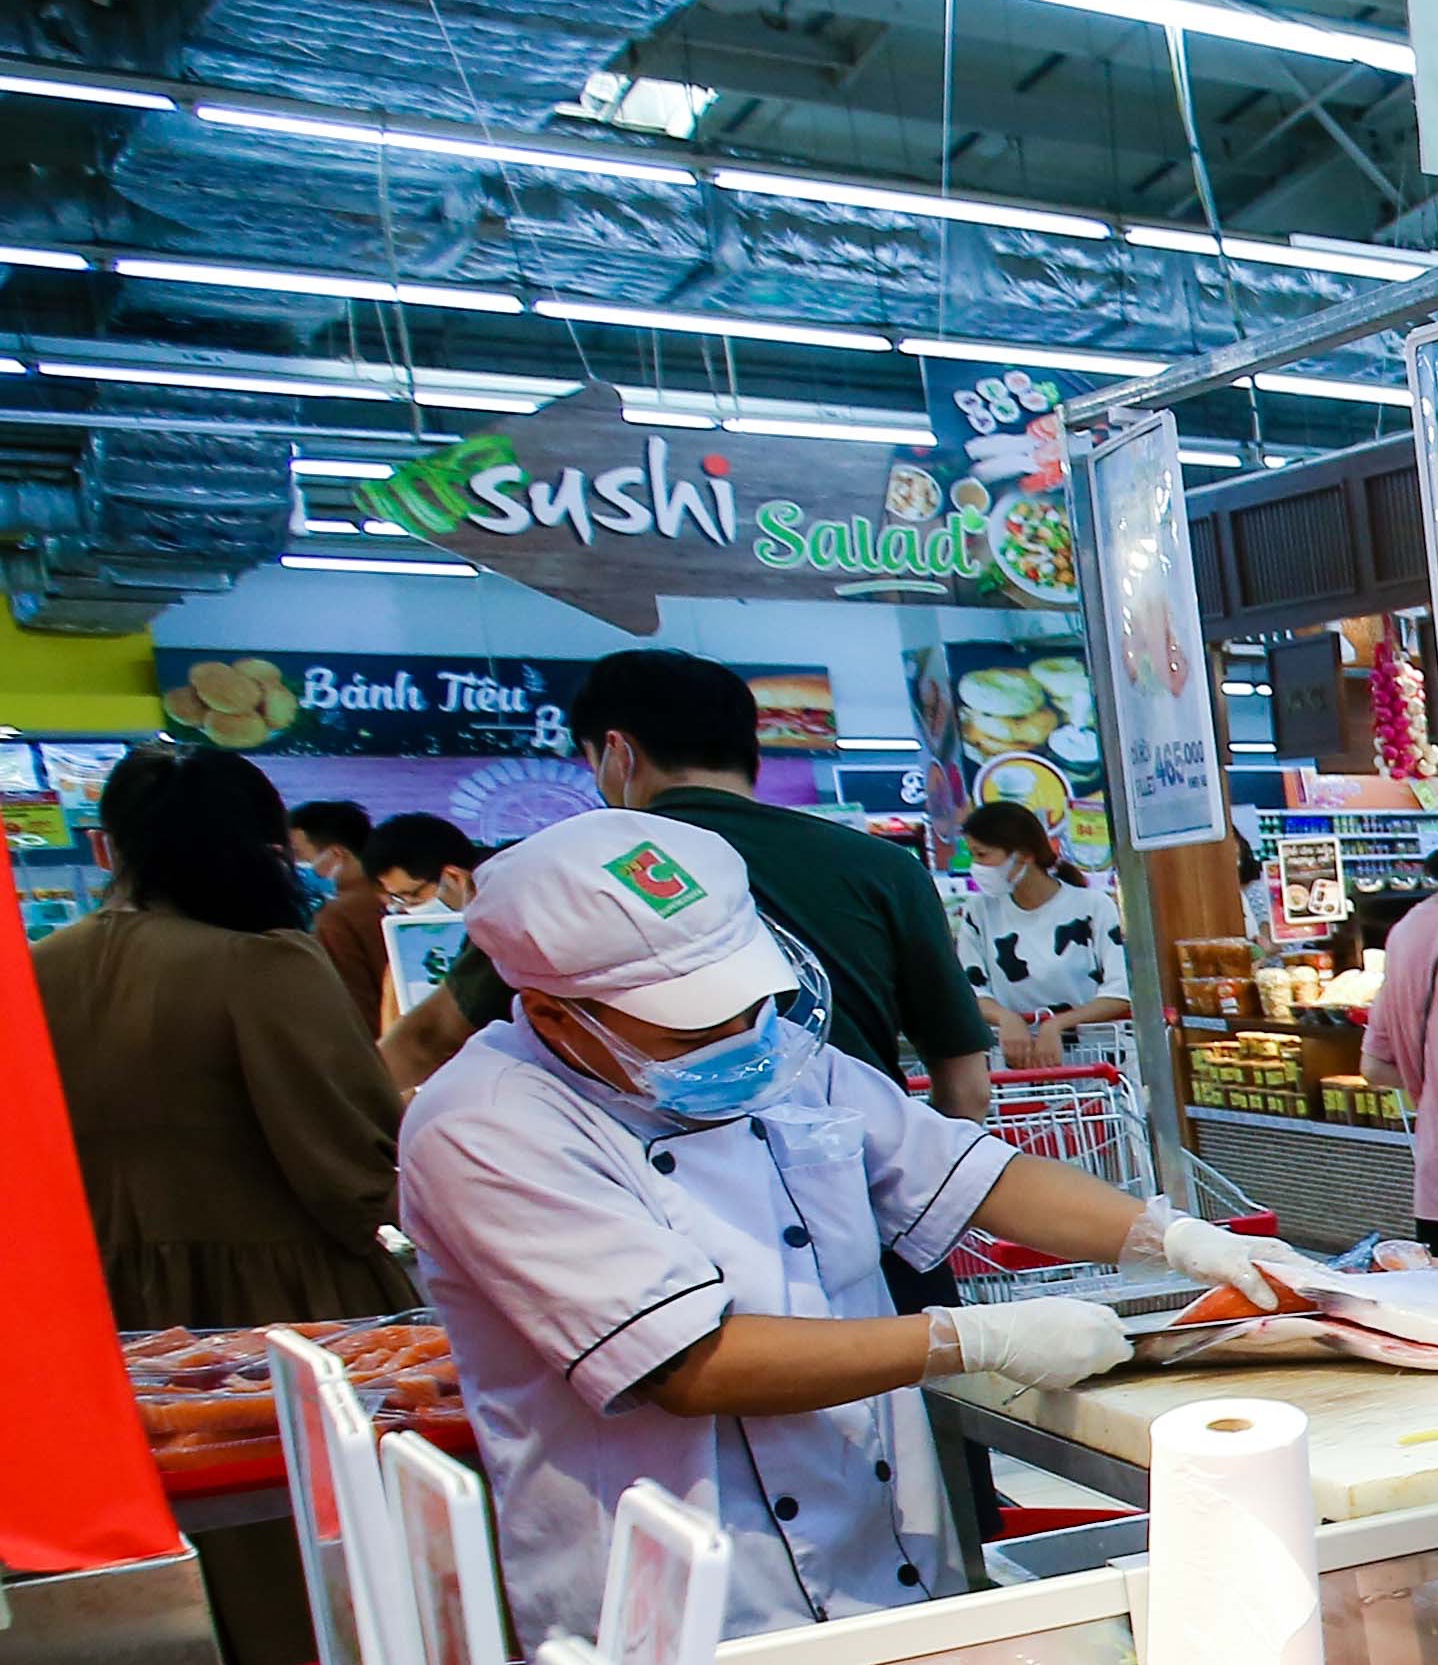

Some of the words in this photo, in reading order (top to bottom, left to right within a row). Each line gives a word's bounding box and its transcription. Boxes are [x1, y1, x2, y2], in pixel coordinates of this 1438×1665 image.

[754, 500, 982, 578] Salad
[300, 666, 426, 711] Bánh
[437, 671, 530, 713] Tiêu
